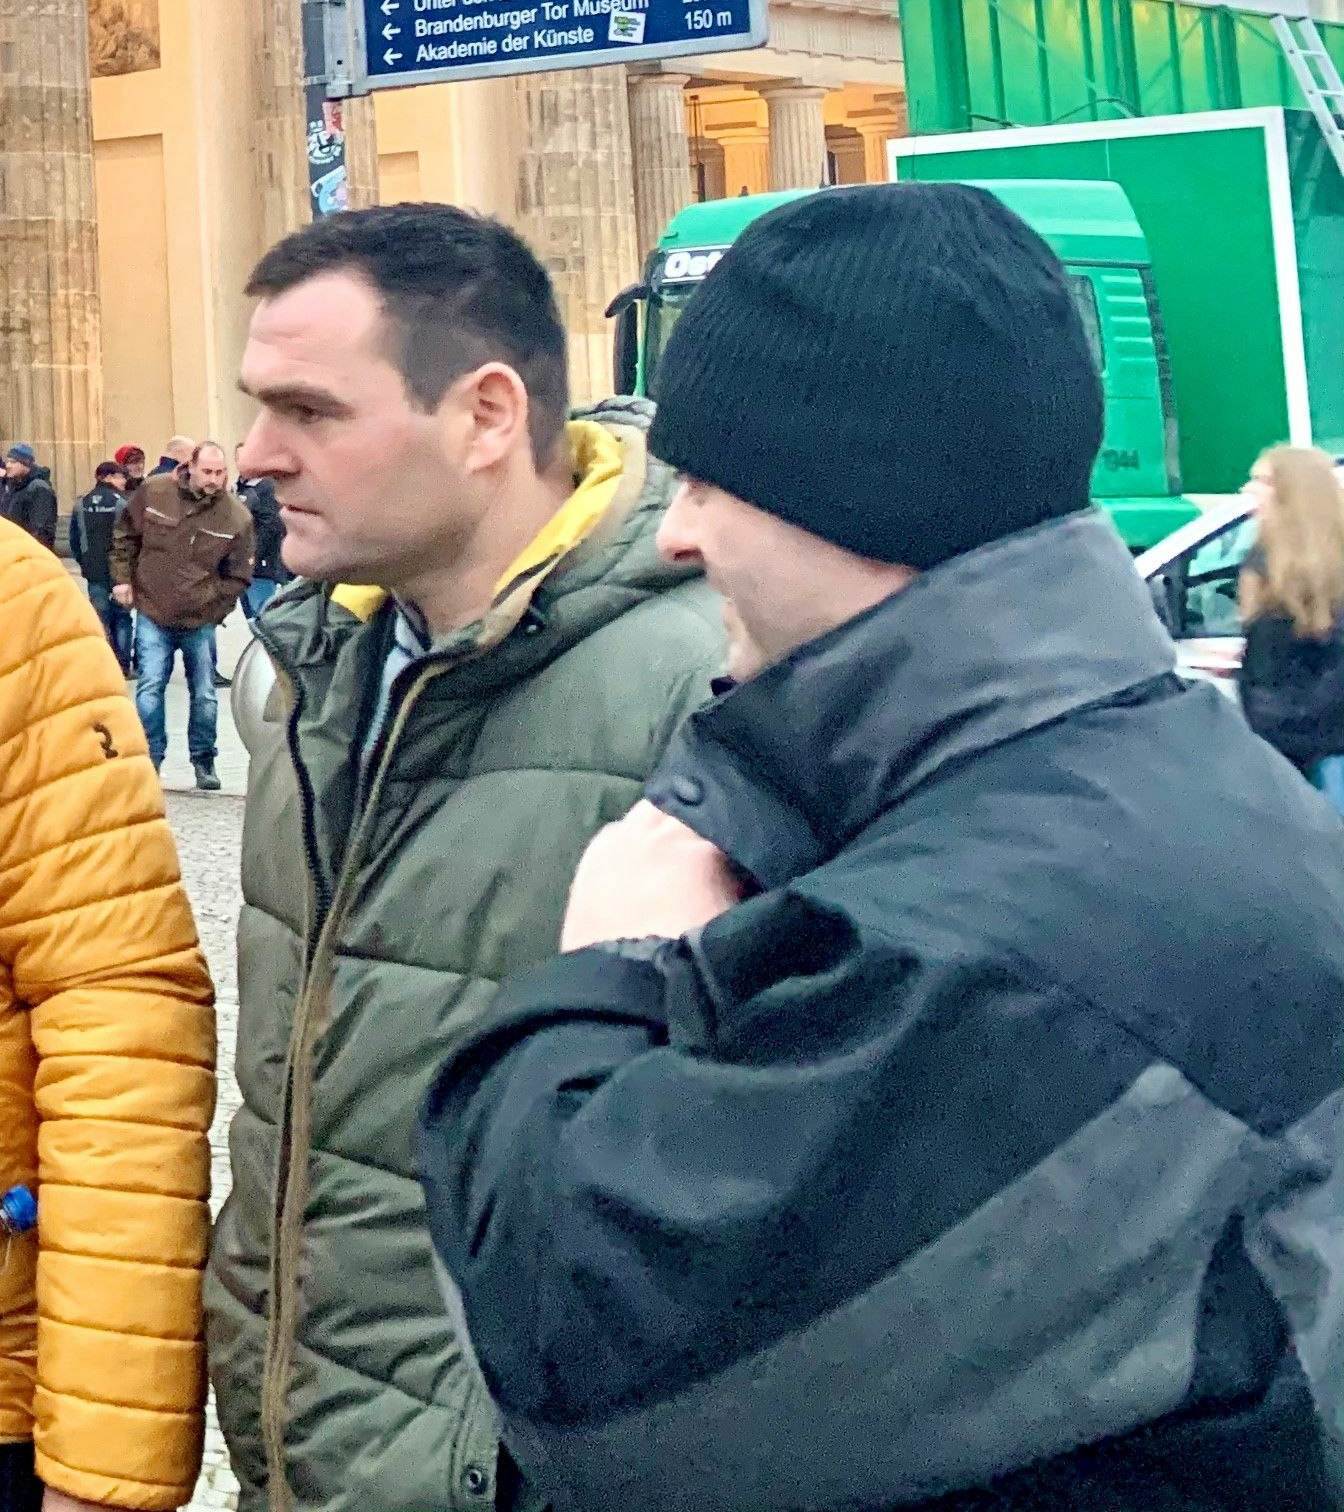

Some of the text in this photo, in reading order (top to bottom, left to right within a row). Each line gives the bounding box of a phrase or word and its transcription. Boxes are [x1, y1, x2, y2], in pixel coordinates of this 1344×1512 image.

[415, 5, 536, 38] Brandenburger
[540, 1, 569, 21] Tor
[684, 8, 731, 31] 150 m
[415, 37, 497, 63] Akademie
[502, 32, 530, 52] der
[534, 24, 594, 48] Künste
